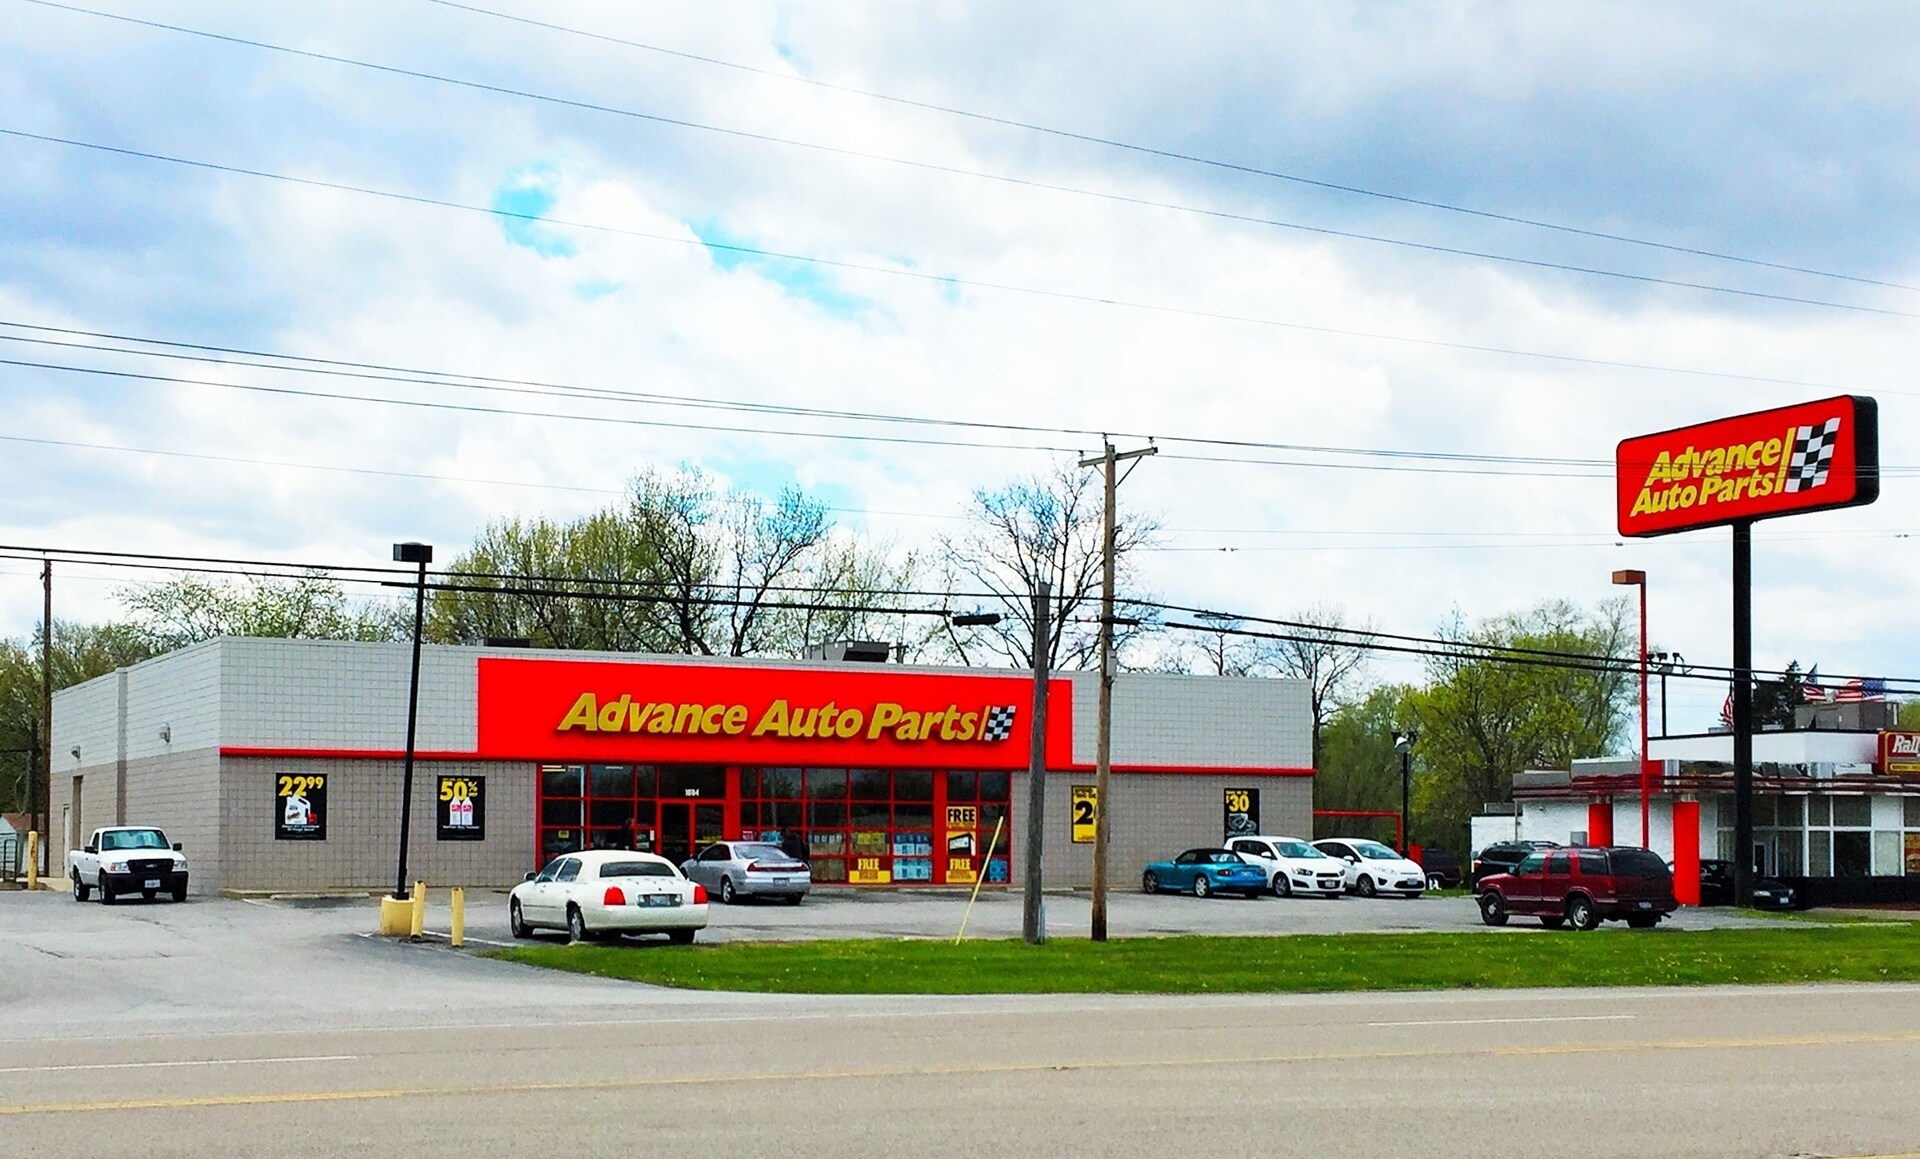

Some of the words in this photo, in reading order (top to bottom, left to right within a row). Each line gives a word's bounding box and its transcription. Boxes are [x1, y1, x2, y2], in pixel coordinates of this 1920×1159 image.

[1644, 437, 1782, 486] Advance
[1630, 484, 1698, 517] Auto
[1699, 468, 1776, 505] Parts
[557, 693, 748, 734] Advance
[751, 700, 863, 738] Auto
[867, 703, 979, 740] Parts
[1892, 735, 1920, 756] Rall
[947, 809, 976, 823] FREE
[858, 858, 880, 870] FREE
[949, 858, 971, 870] FREE
